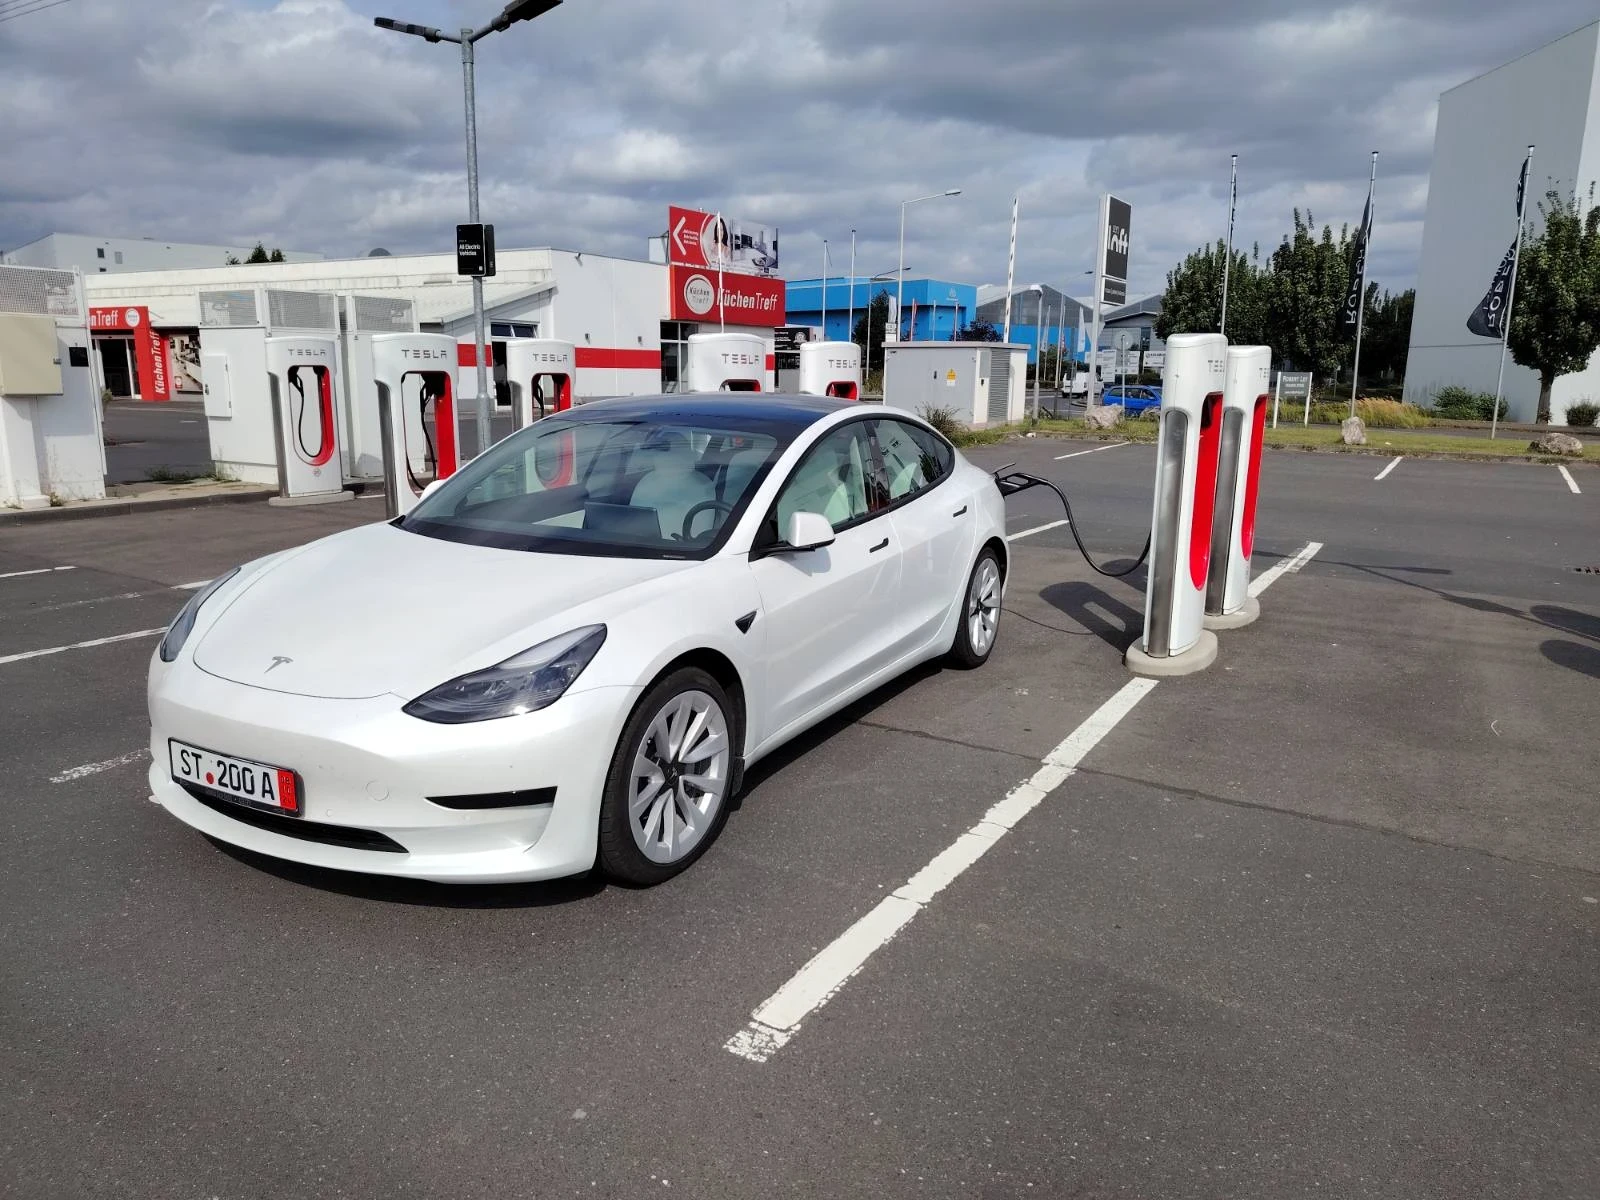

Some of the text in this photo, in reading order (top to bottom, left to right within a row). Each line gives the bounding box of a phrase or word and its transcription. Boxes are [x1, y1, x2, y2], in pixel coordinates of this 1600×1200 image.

[401, 349, 448, 359] TESLA
[532, 353, 568, 362] TESLA
[721, 353, 760, 365] TESLA
[149, 330, 166, 394] KüchenTreff
[828, 359, 857, 369] TESLA
[180, 749, 202, 780] ST
[217, 760, 255, 795] 200
[262, 772, 275, 801] A
